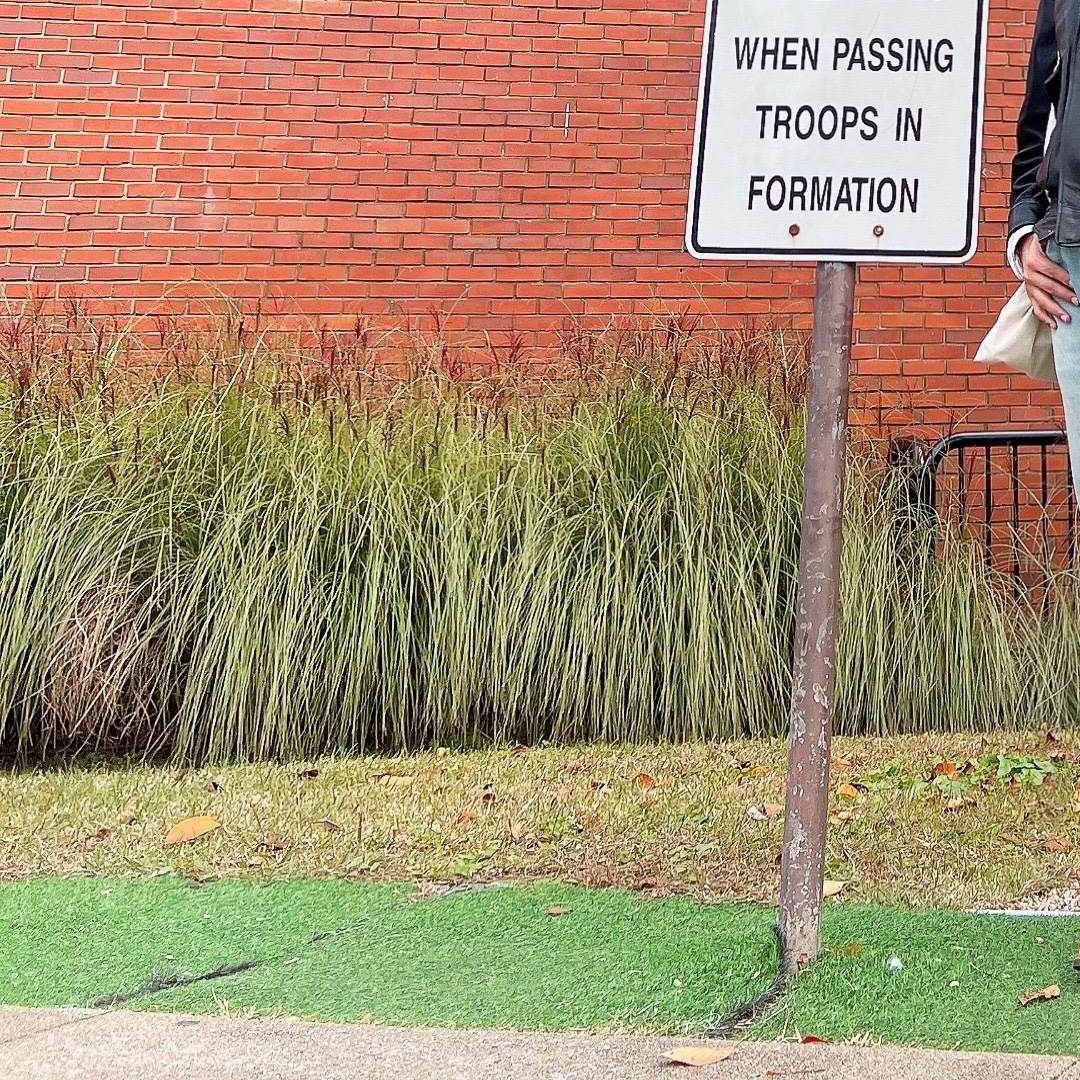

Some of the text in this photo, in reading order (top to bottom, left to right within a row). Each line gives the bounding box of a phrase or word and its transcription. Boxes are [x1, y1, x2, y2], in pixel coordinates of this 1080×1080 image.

[734, 36, 954, 73] WHEN PASSING
[755, 105, 923, 142] TROOPS IN
[747, 175, 919, 213] FORMATION
